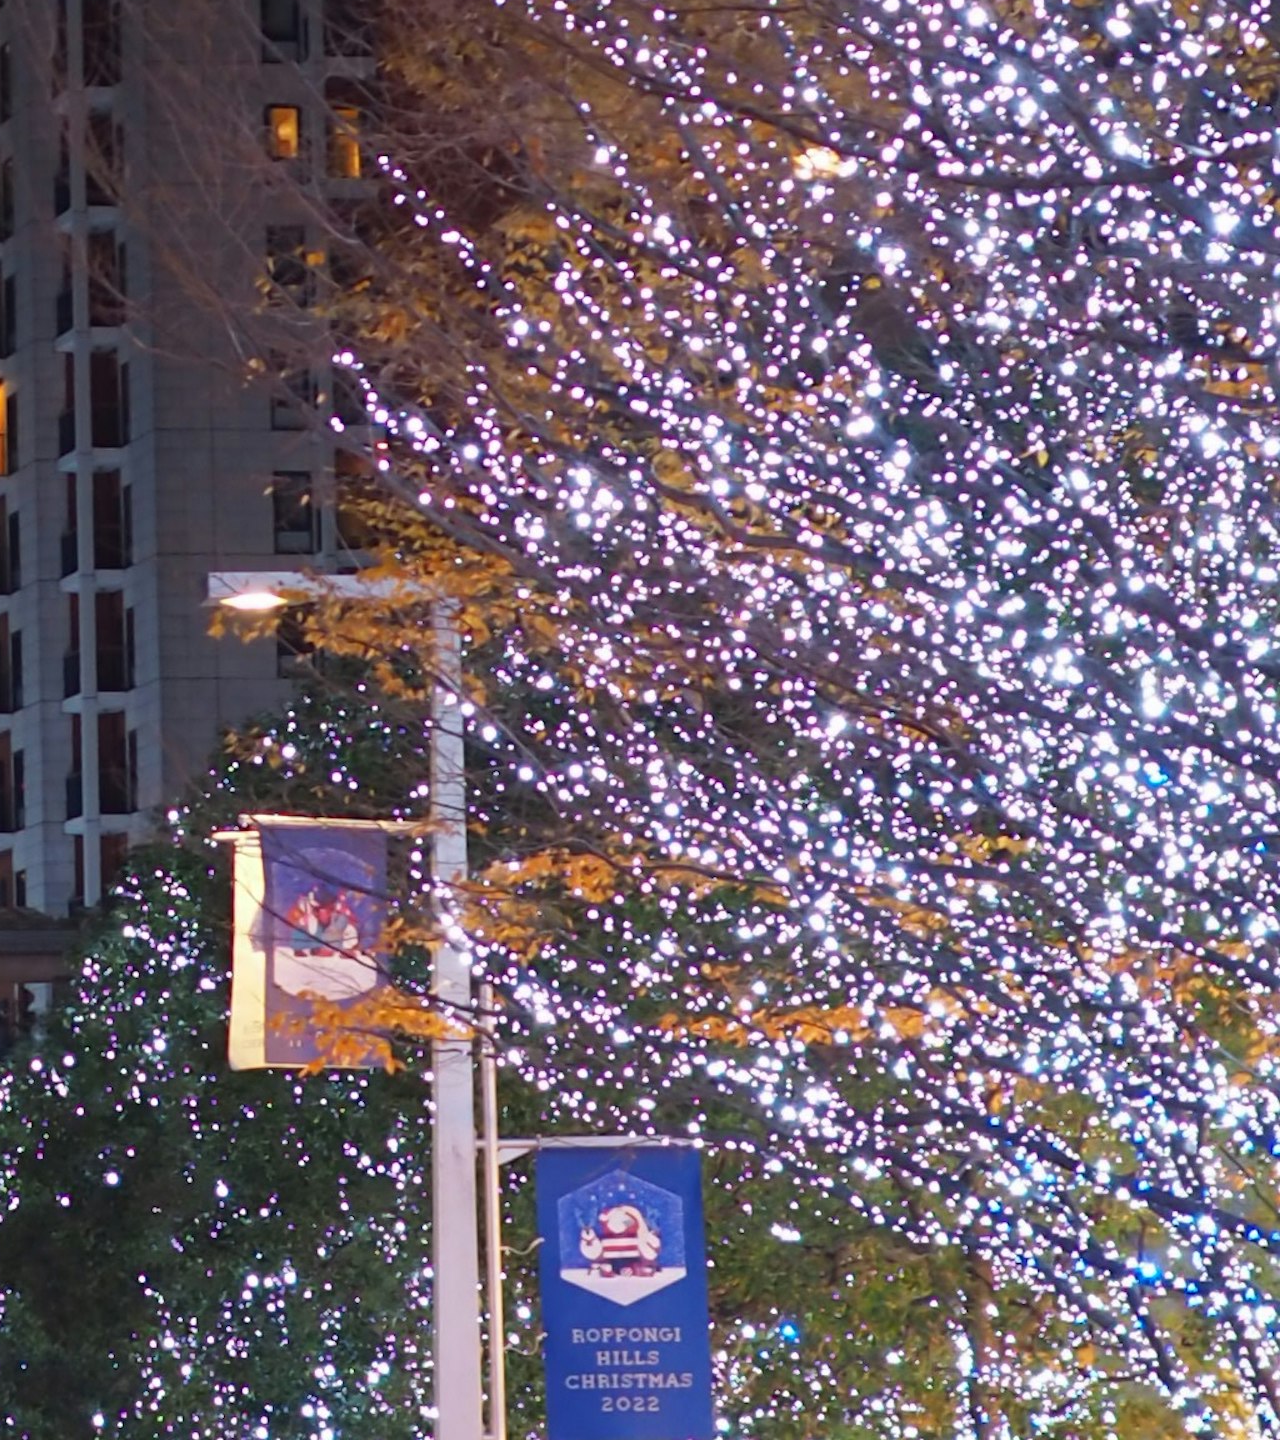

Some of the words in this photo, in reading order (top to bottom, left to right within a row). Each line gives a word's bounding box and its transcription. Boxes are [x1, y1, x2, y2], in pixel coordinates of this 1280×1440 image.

[571, 1327, 682, 1344] ROPPONGI
[596, 1350, 660, 1366] HILLS
[565, 1372, 693, 1390] CHRISTMAS
[601, 1396, 660, 1412] 2022
